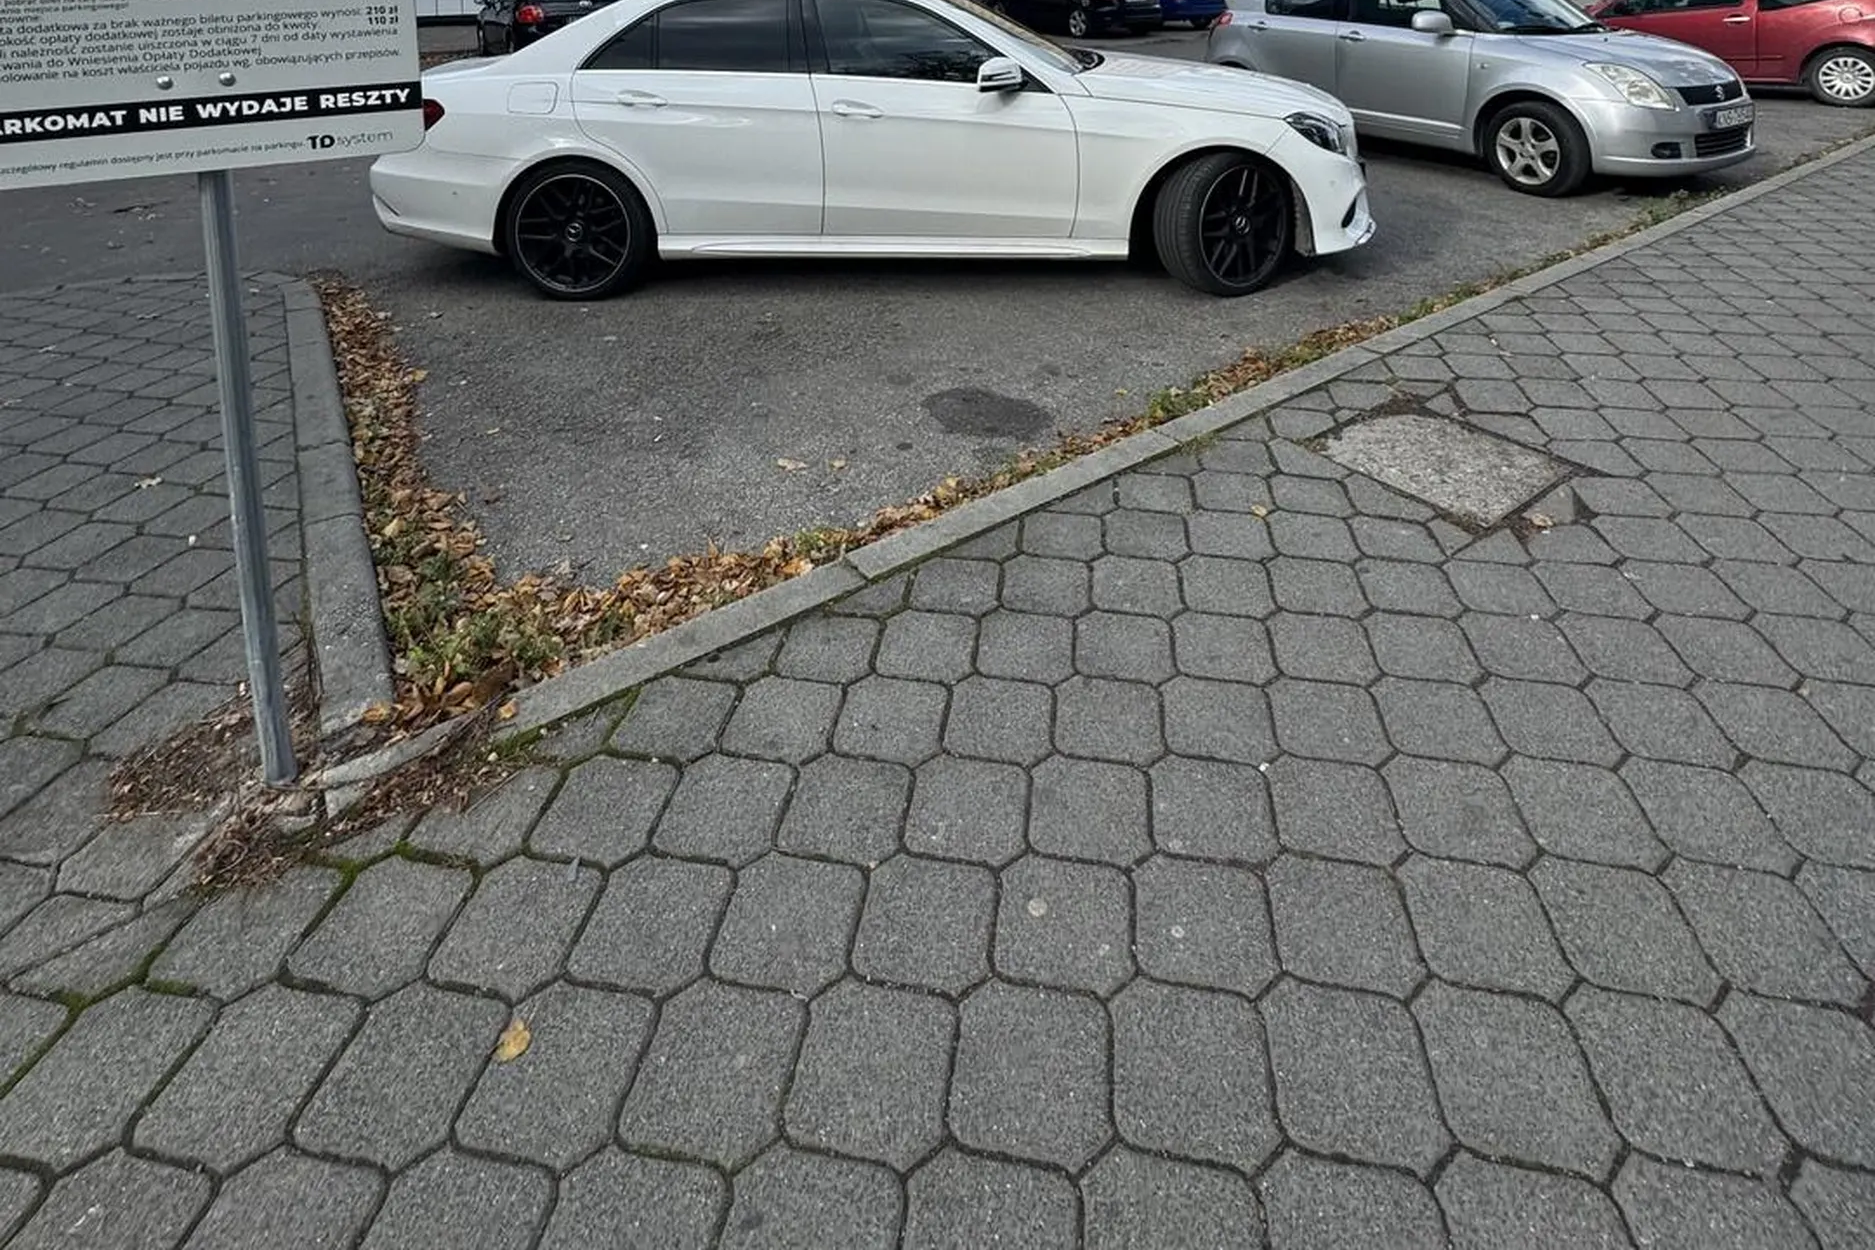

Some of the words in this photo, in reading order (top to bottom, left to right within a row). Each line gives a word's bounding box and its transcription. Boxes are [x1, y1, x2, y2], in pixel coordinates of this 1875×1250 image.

[17, 22, 89, 35] dodatkowa
[93, 22, 107, 31] za
[110, 18, 139, 30] brak
[40, 34, 81, 46] opłaty
[85, 30, 158, 42] dodatkowej
[265, 21, 280, 31] do
[11, 46, 78, 59] należność
[81, 43, 135, 55] zostanie
[201, 38, 212, 47] w
[261, 31, 280, 43] dni
[283, 31, 299, 42] od
[302, 30, 327, 42] daty
[47, 57, 64, 68] do
[142, 50, 184, 63] Opłaty
[63, 69, 79, 79] na
[0, 110, 127, 136] RKOMAT
[139, 105, 185, 126] NIE
[196, 96, 309, 119] WYDAJE
[319, 88, 411, 109] RESZTY
